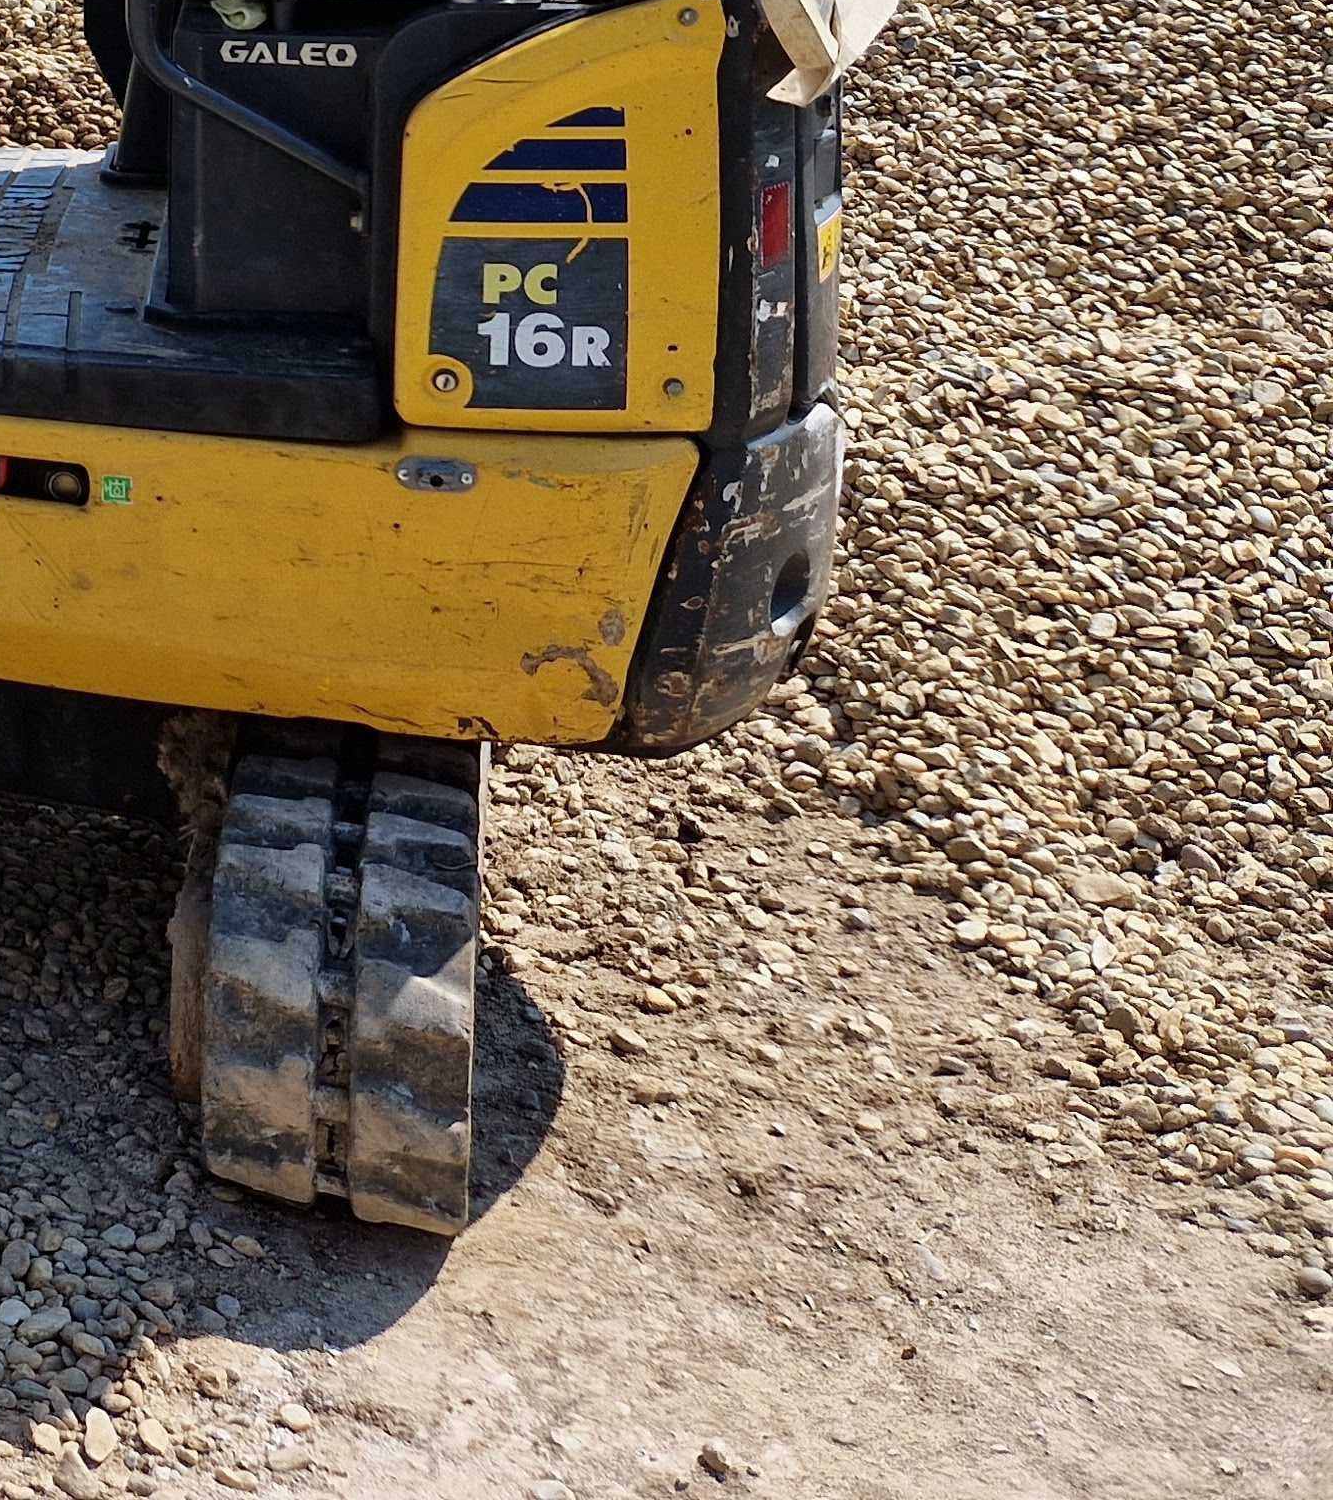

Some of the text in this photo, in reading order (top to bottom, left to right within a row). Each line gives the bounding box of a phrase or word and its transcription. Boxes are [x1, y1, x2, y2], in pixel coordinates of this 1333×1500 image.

[219, 39, 358, 68] GALEO
[482, 262, 559, 306] PC
[477, 311, 613, 369] 16R
